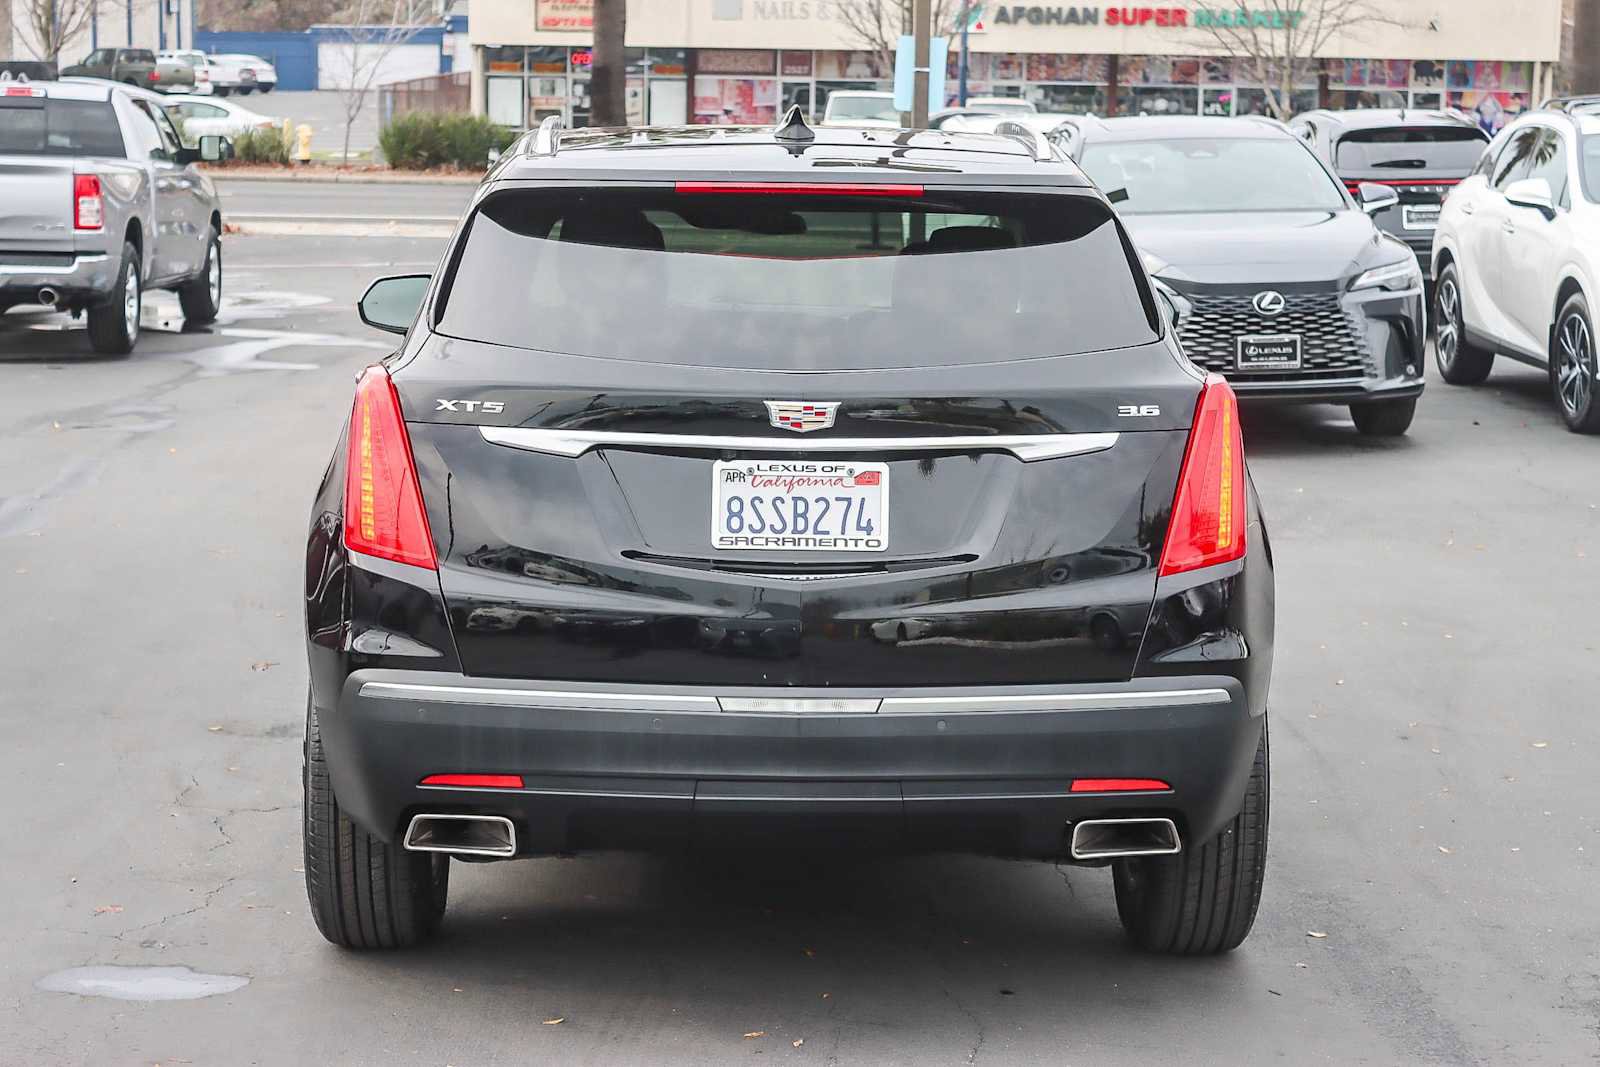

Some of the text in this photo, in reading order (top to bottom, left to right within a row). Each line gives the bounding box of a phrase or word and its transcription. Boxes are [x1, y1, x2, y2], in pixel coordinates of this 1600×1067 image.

[752, 1, 809, 21] NAILS
[993, 6, 1305, 29] AFGHAN SUPER MARKET
[1258, 346, 1293, 354] LEXUS
[756, 464, 846, 473] LEXUS OF
[725, 471, 746, 483] APR
[751, 474, 855, 494] California
[726, 495, 874, 536] 8SSB274
[718, 536, 882, 549] SACRAMENTO
